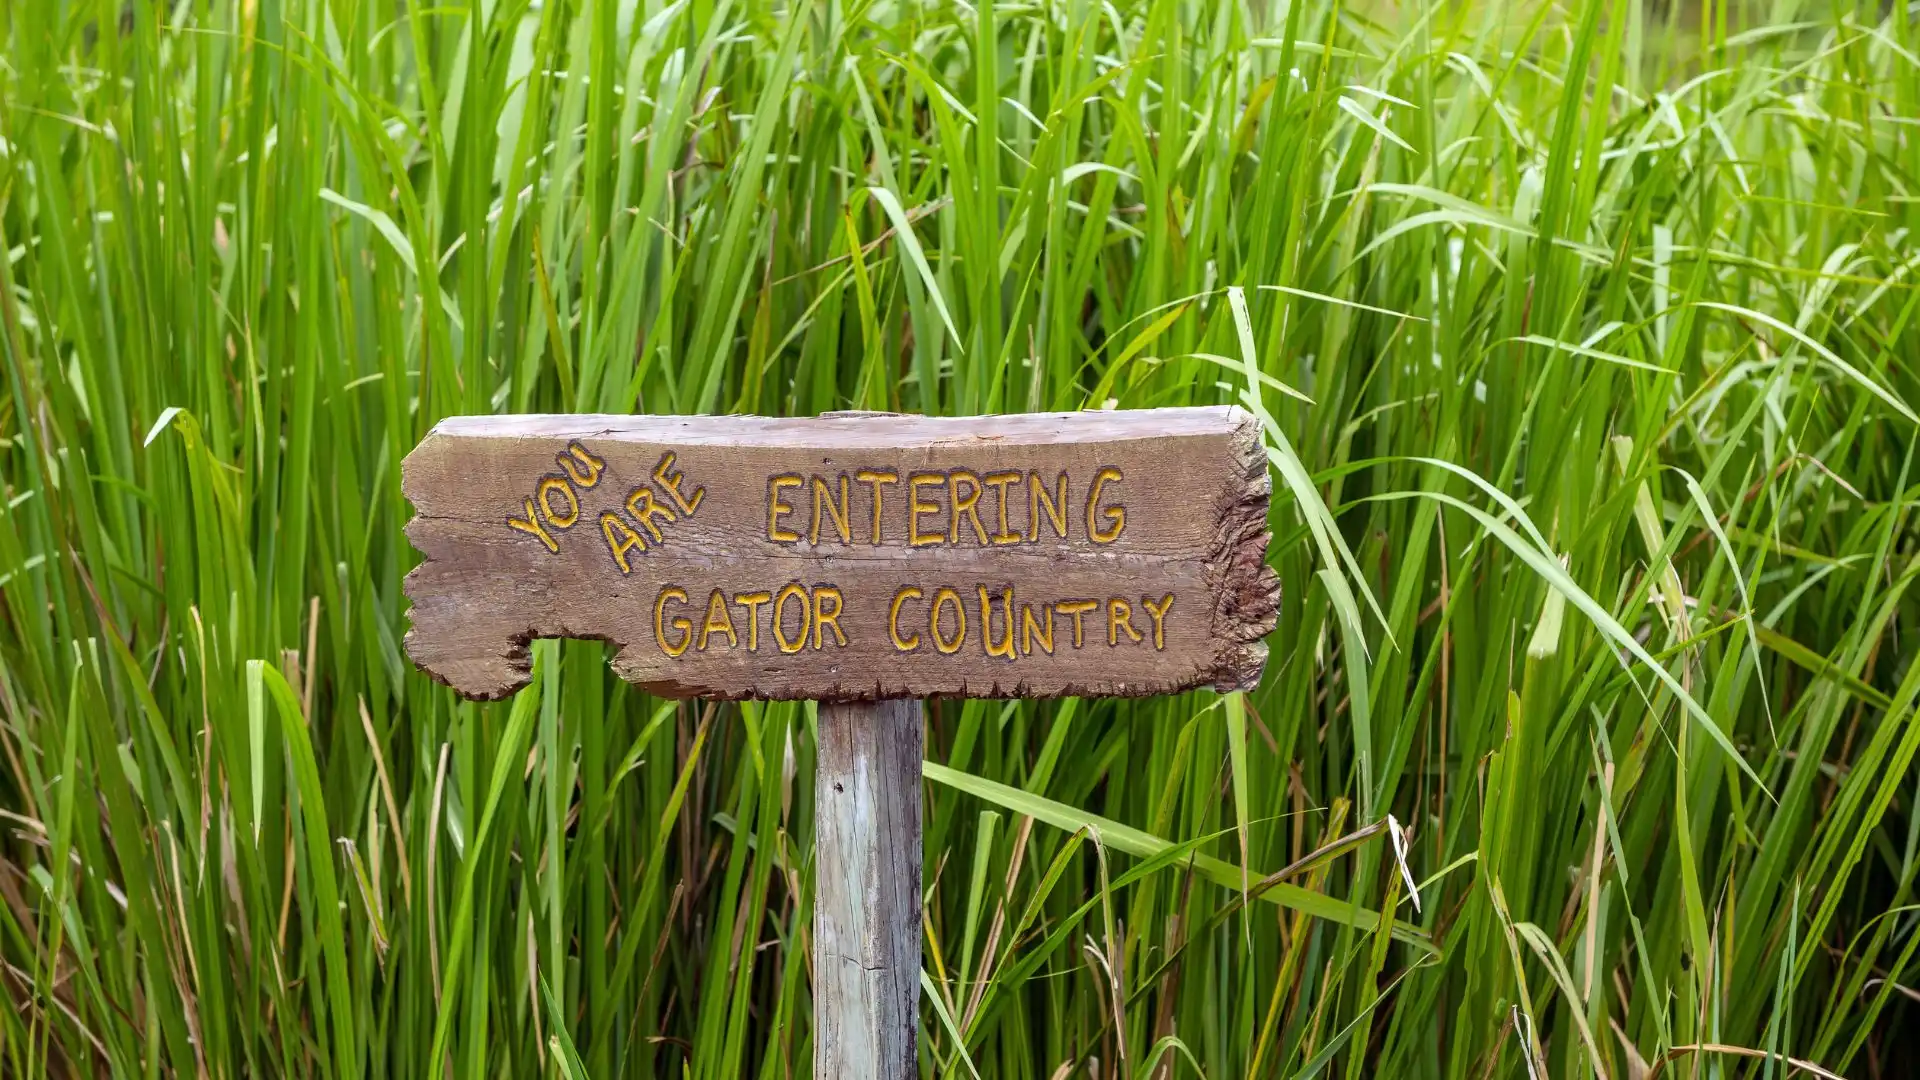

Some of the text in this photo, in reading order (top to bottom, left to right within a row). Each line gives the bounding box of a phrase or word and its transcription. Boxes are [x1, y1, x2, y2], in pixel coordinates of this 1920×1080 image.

[507, 440, 606, 554] YOU
[600, 451, 705, 574] ARE
[767, 466, 1126, 546] ENTERING
[654, 580, 1175, 660] GATOR COUNTRY
